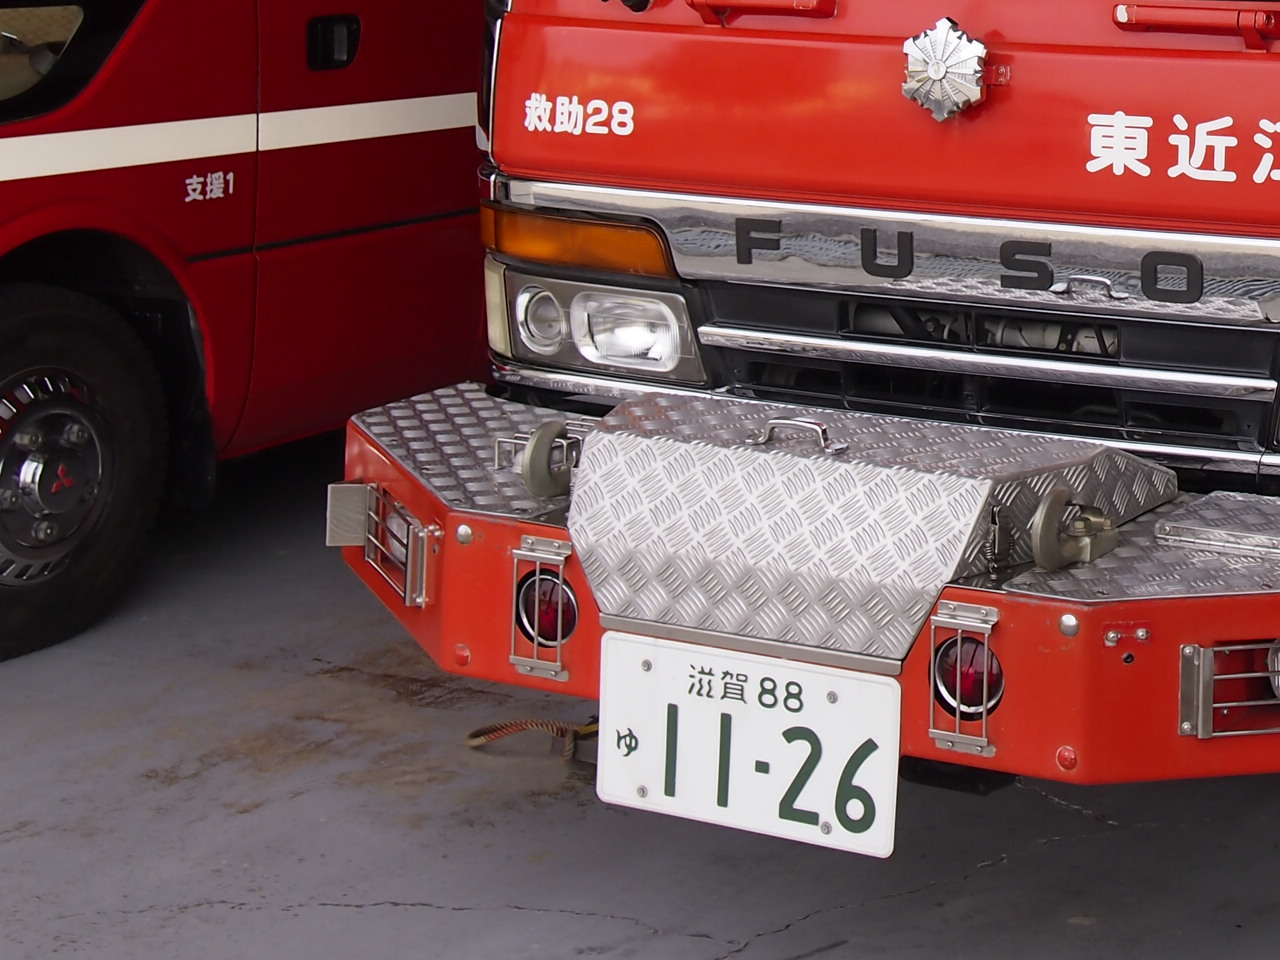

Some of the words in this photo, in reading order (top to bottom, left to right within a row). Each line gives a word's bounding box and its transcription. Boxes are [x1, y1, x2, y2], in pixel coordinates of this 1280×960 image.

[524, 92, 635, 136] 救助28
[184, 171, 234, 203] 支援1
[734, 217, 1204, 303] FUSO
[687, 663, 748, 705] 滋賀
[757, 676, 804, 713] 88
[615, 727, 639, 757] ゆ
[654, 702, 880, 834] 11-26
